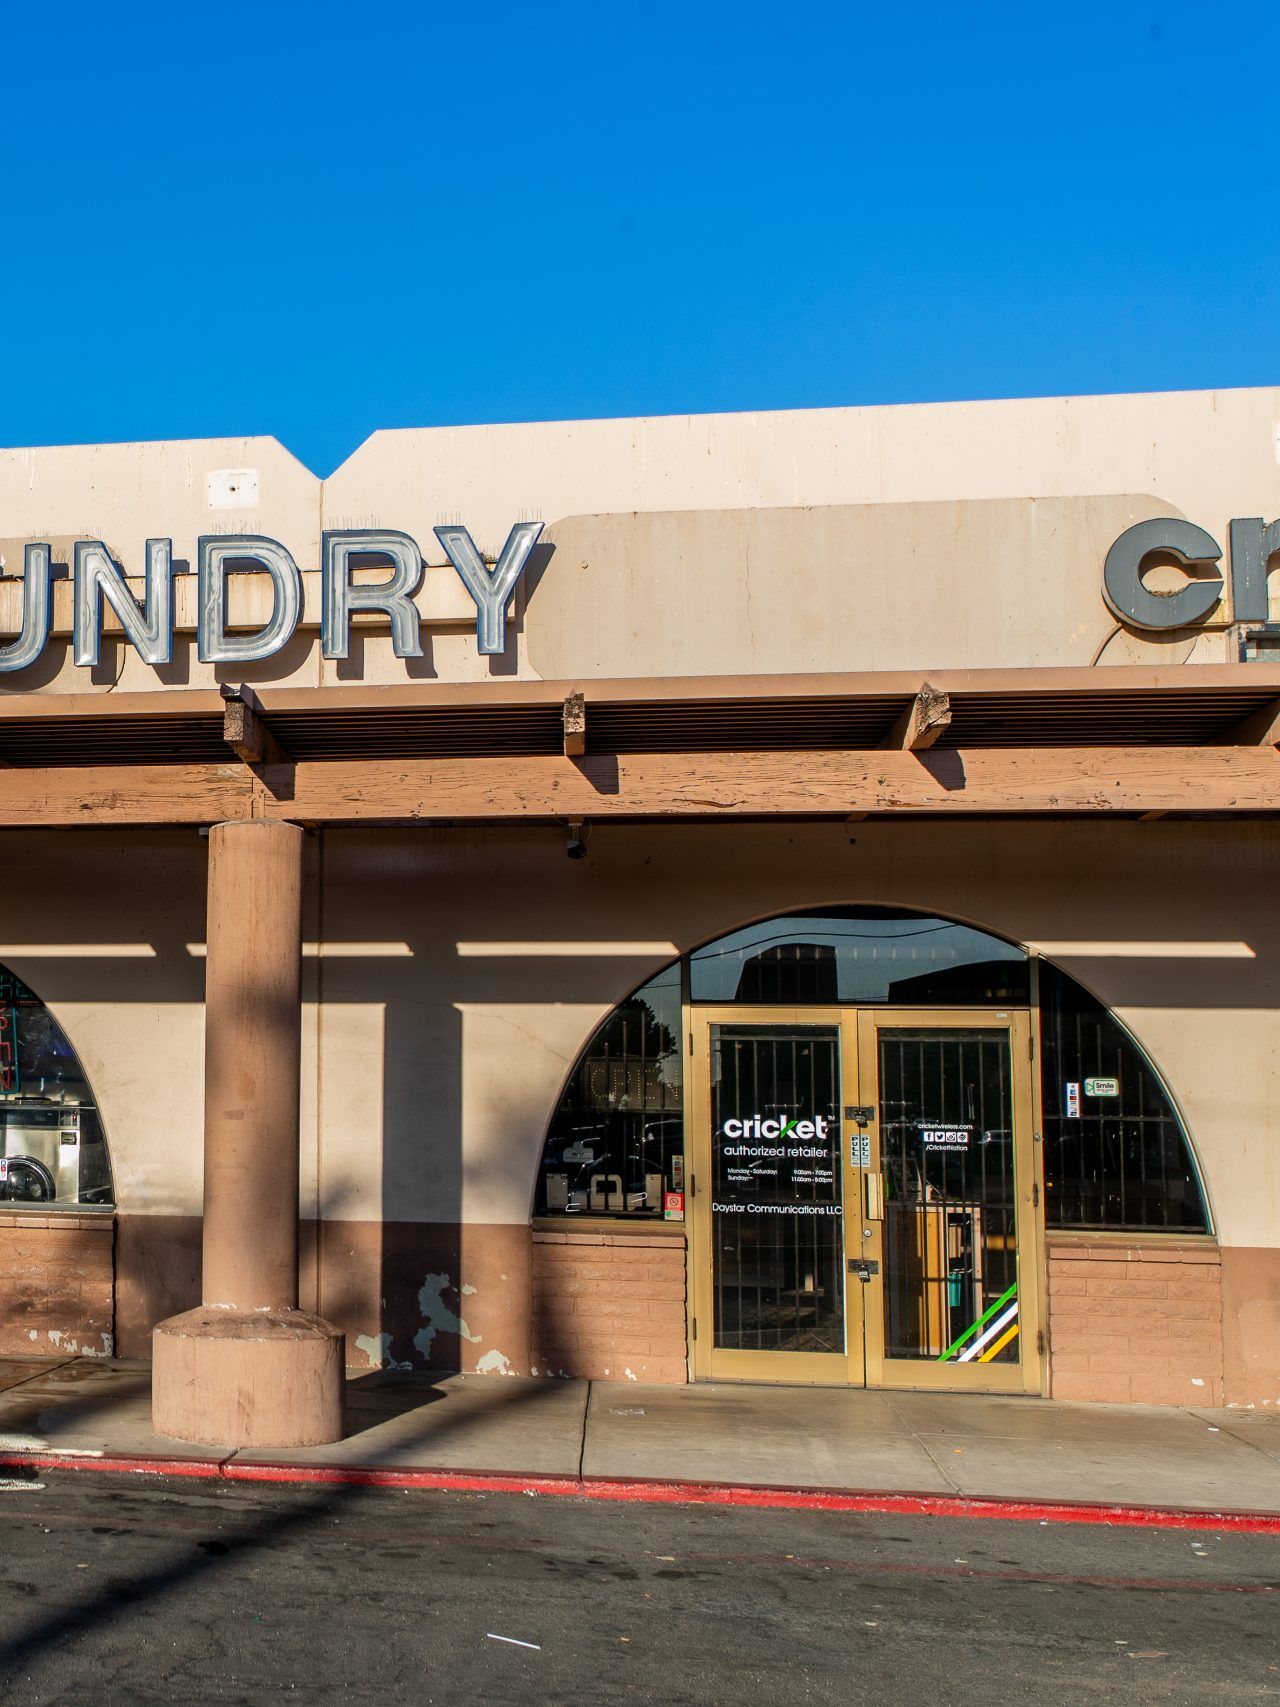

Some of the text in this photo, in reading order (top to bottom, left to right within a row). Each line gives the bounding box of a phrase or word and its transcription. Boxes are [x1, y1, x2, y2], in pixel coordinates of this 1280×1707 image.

[723, 1114, 828, 1139] cricket
[917, 1122, 973, 1130] cricketwireless.com
[723, 1145, 828, 1158] authorized retailer
[851, 1136, 859, 1157] PULL
[861, 1136, 869, 1157] PULL
[926, 1144, 968, 1152] /CricketNation
[727, 1168, 750, 1176] Monday
[712, 1202, 843, 1215] Daystar Communications LLC
